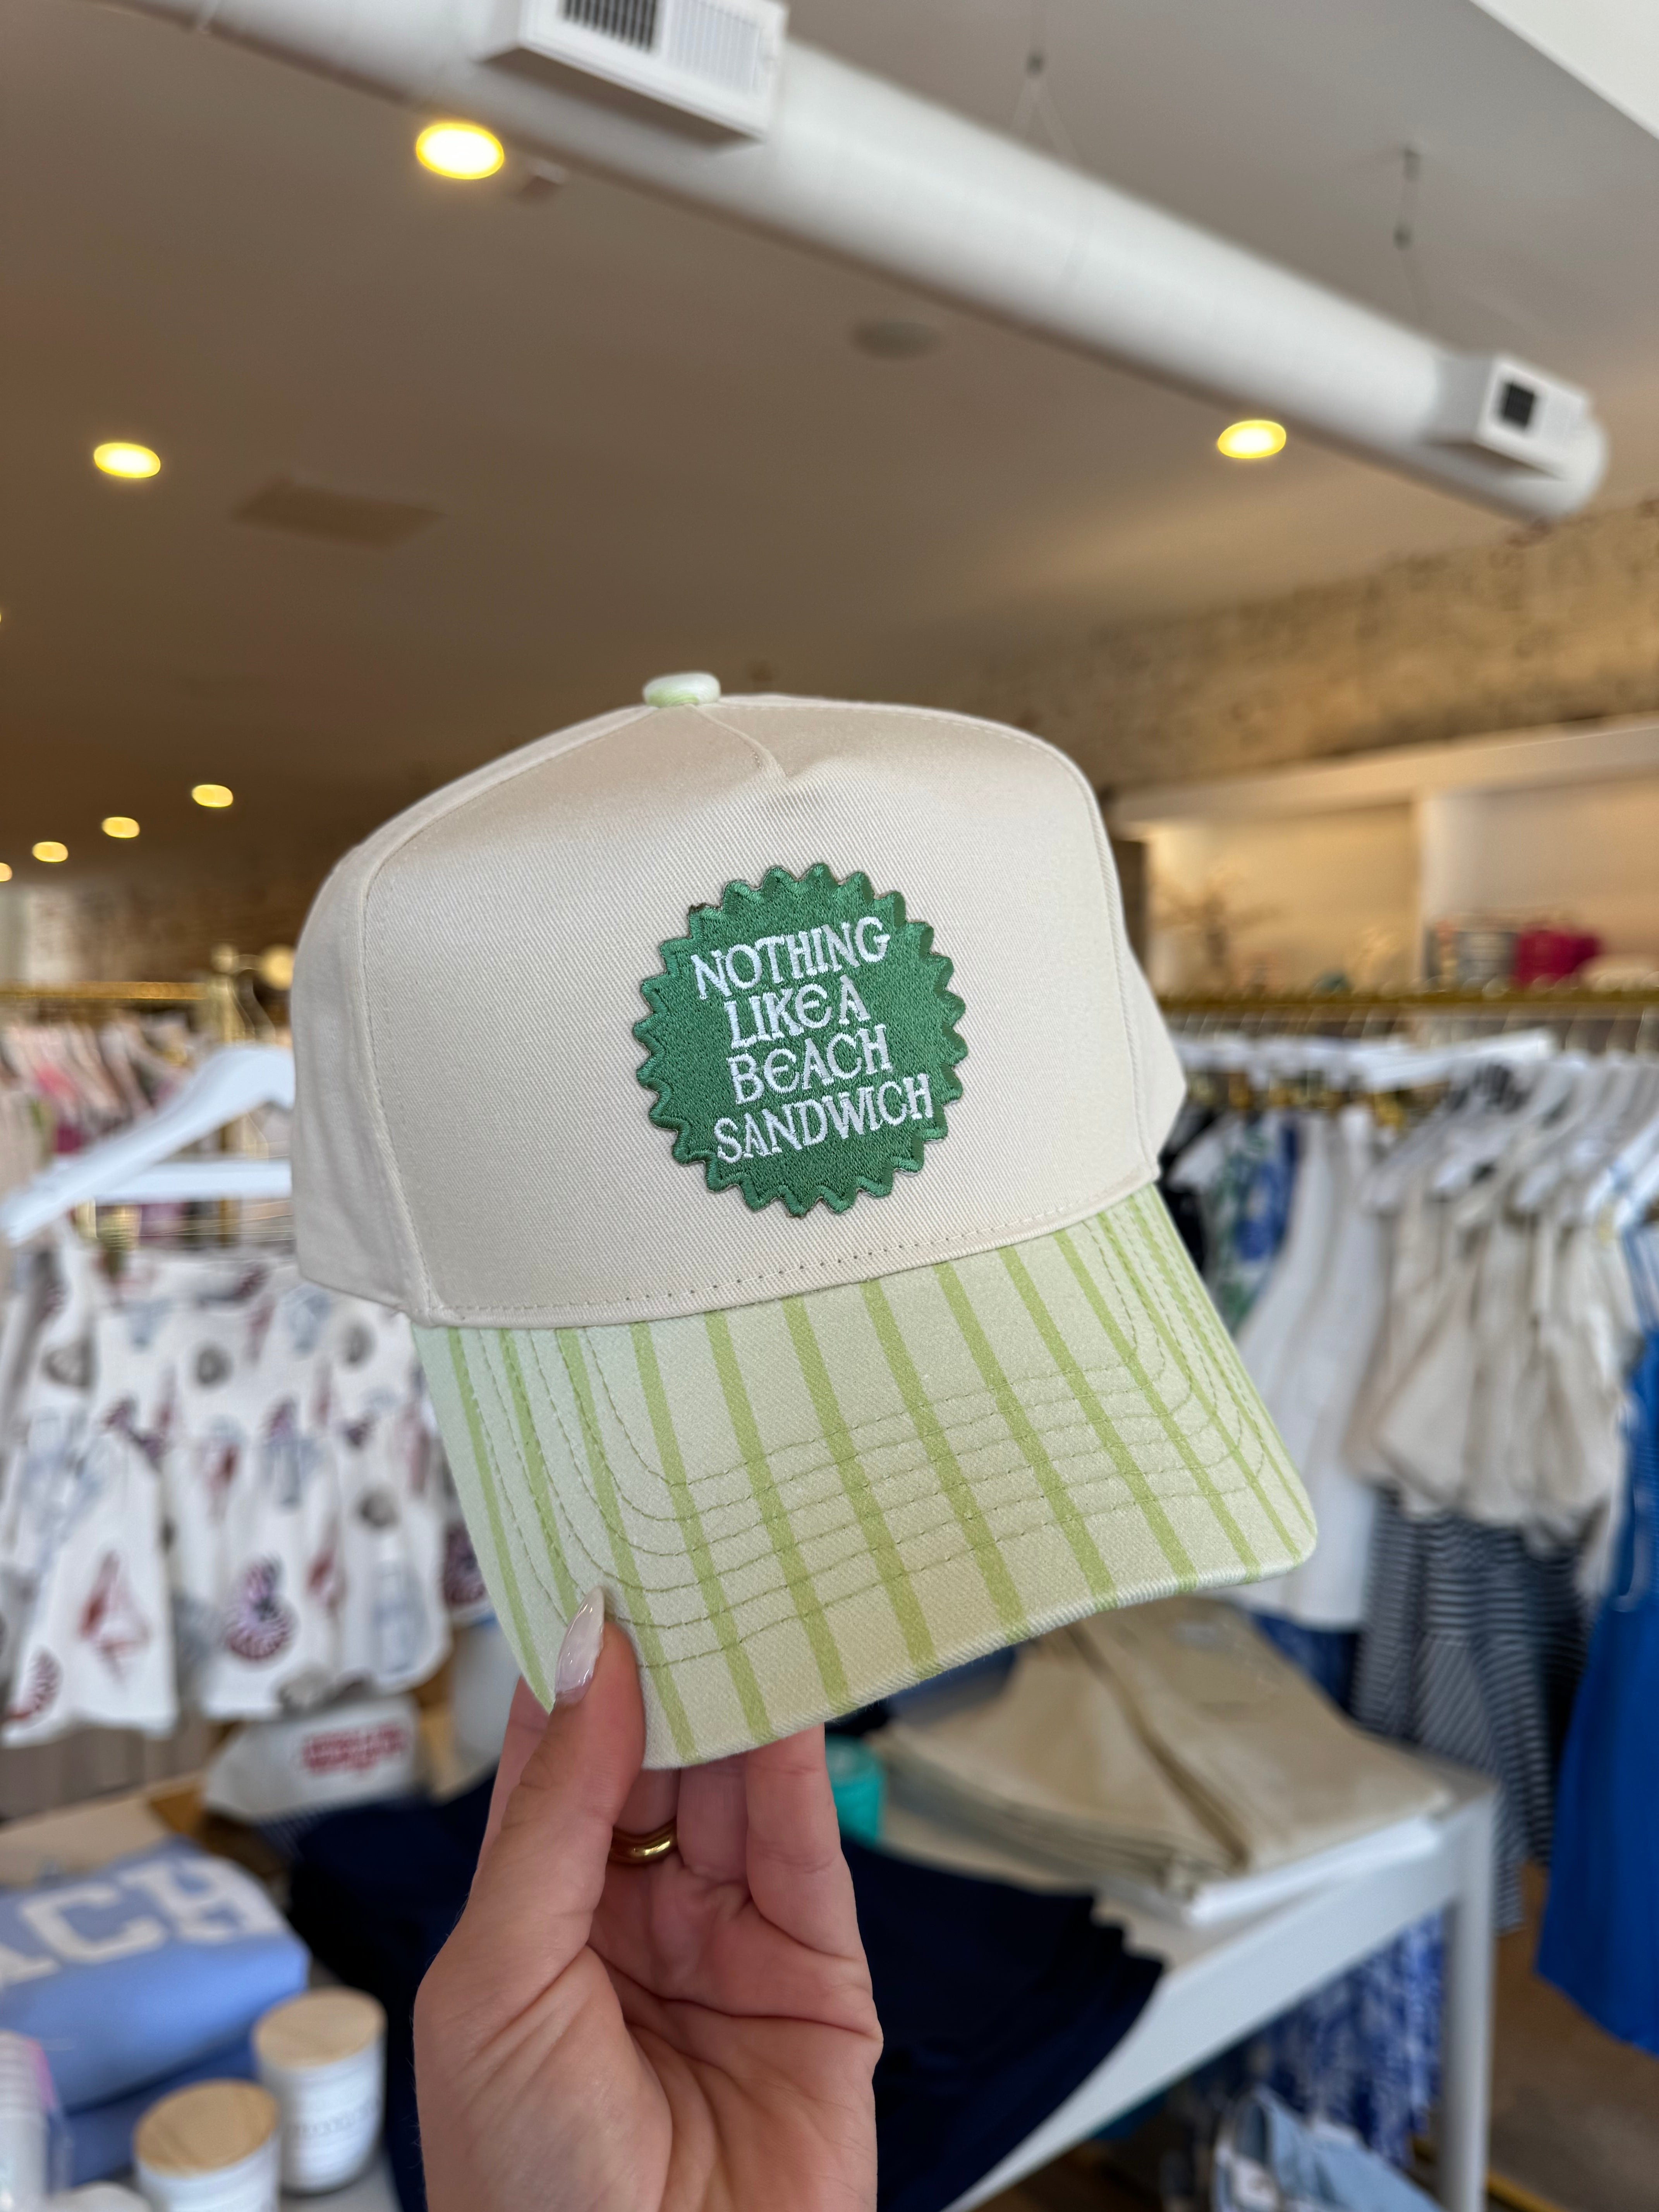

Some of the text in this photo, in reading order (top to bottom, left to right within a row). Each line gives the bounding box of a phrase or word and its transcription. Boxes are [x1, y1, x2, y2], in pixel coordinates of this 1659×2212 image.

[690, 916, 890, 1000] NOTHING
[724, 975, 871, 1050] LIKE A
[727, 1024, 894, 1105] BEACH
[714, 1073, 934, 1163] SANDWICH
